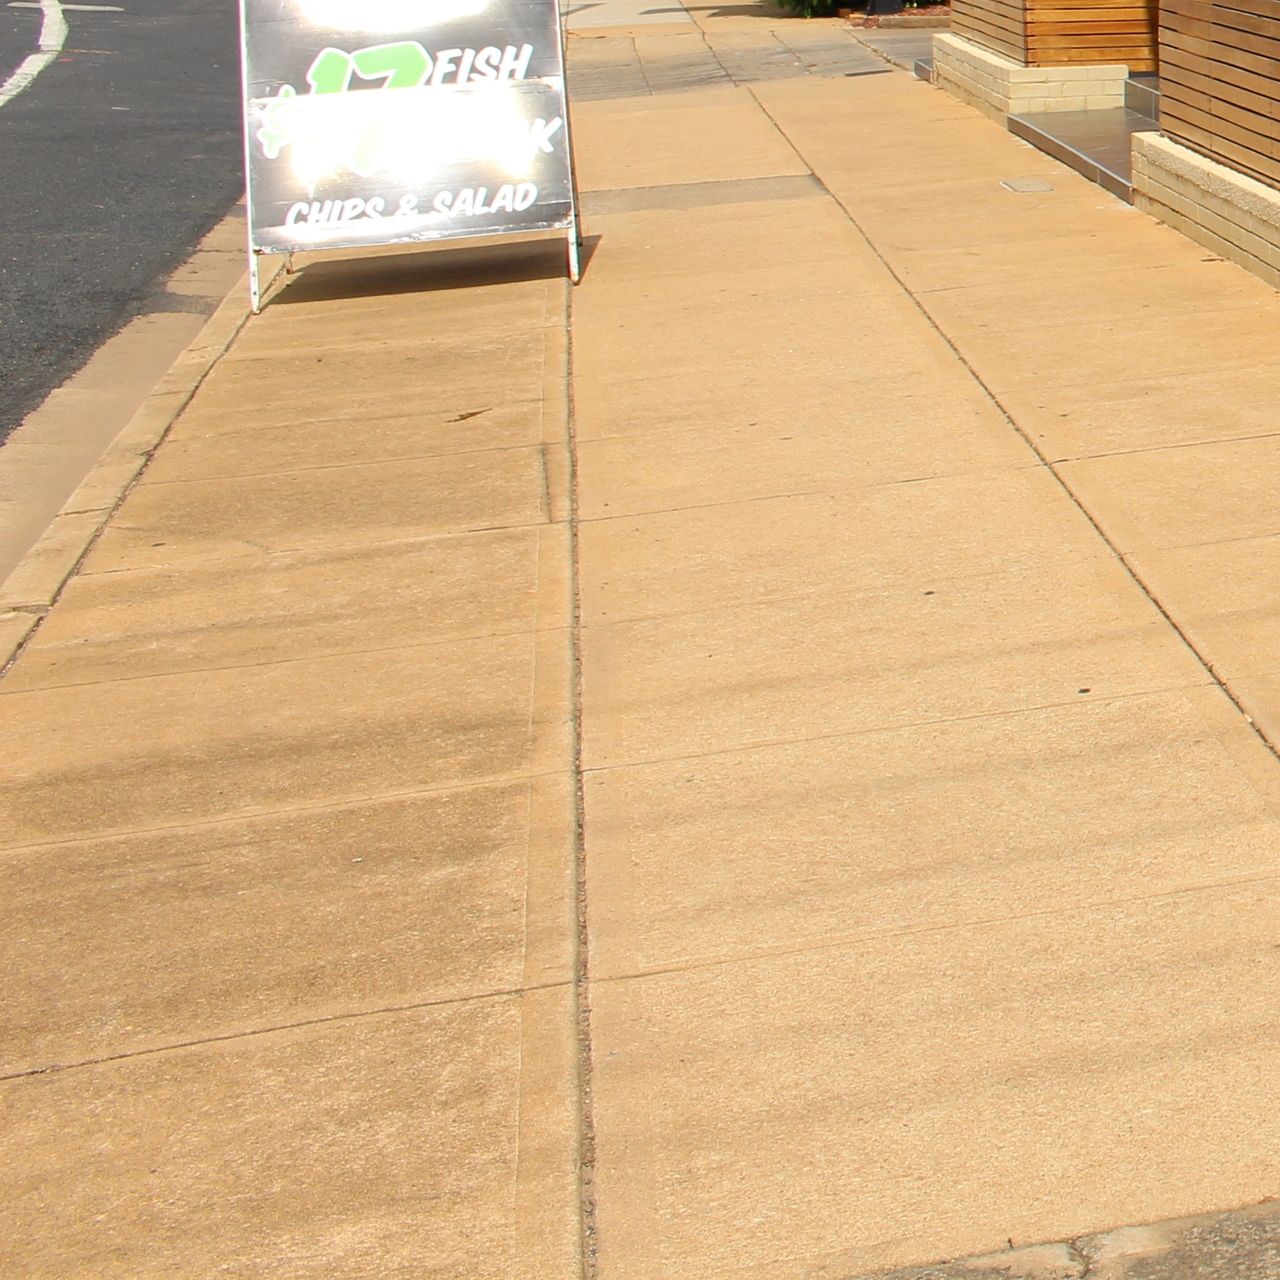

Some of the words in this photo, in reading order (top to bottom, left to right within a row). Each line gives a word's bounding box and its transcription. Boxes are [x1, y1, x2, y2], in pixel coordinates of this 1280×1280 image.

[430, 43, 535, 86] FISH
[284, 196, 386, 229] CHIPS
[392, 193, 420, 218] &
[432, 181, 539, 220] SALAD
